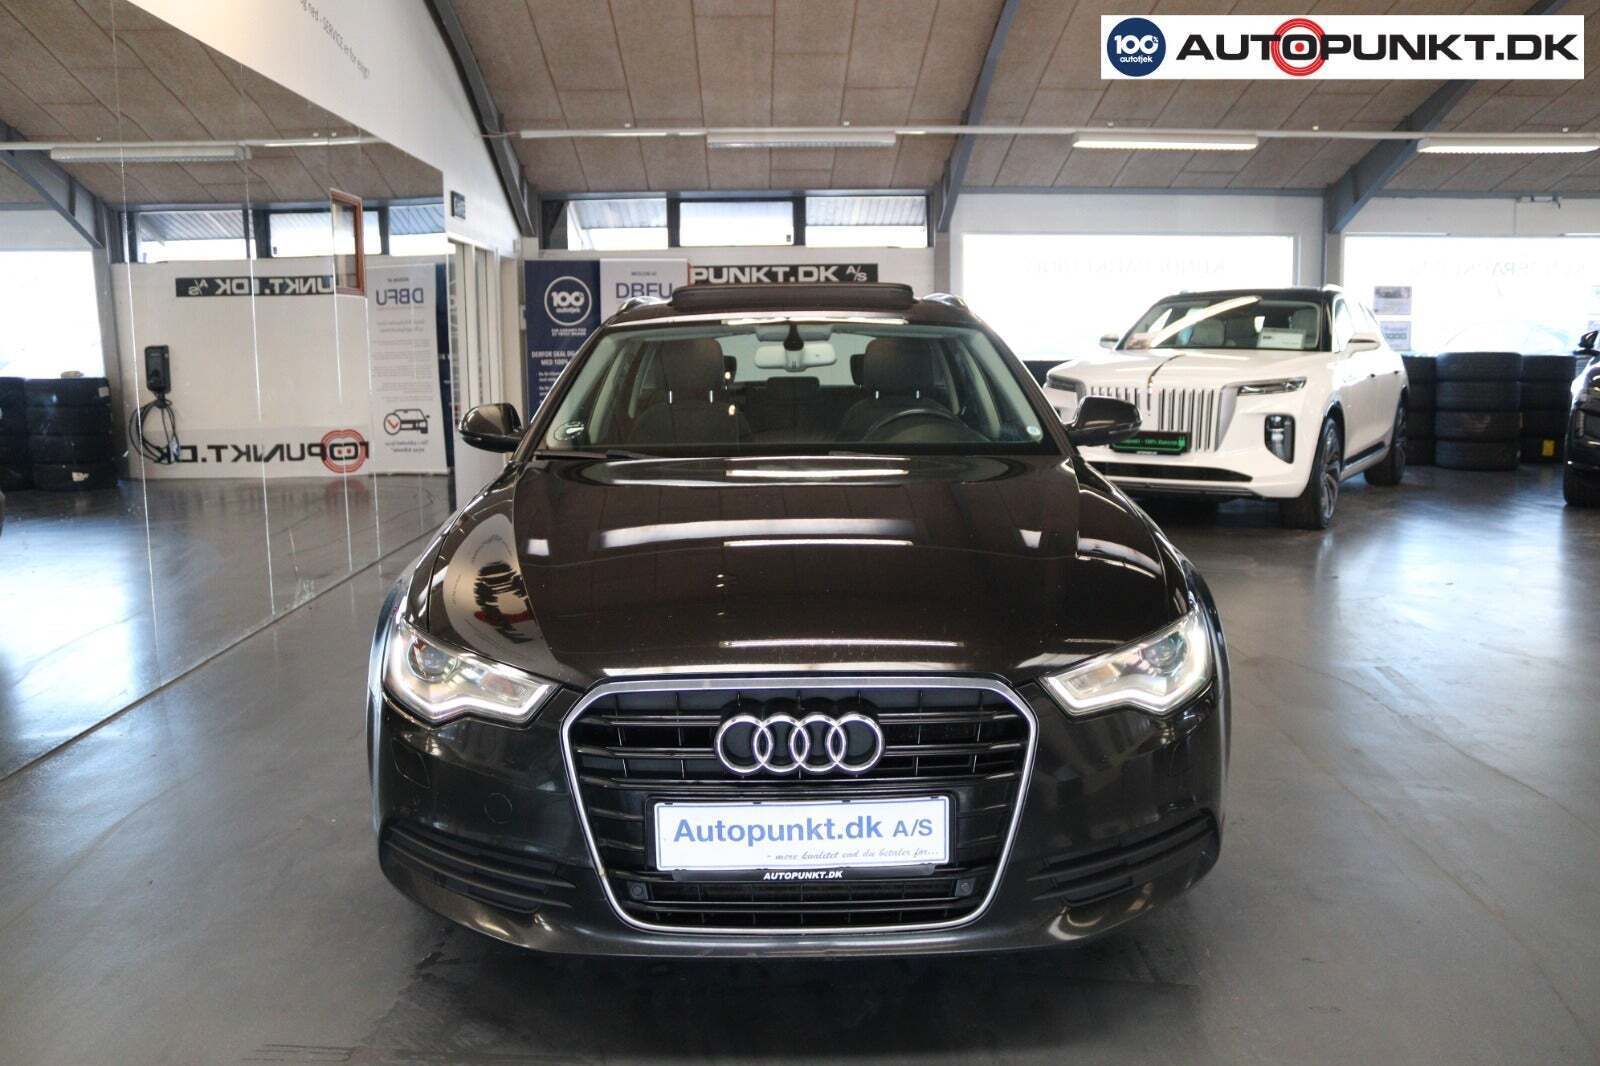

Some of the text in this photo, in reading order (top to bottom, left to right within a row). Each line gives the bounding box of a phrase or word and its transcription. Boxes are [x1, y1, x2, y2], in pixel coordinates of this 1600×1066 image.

[690, 265, 839, 284] PUNKT.DK
[616, 282, 673, 299] DBFU
[673, 815, 934, 847] Autopunkt.dk A/S
[763, 870, 843, 881] AUTOPUNKT.DK
